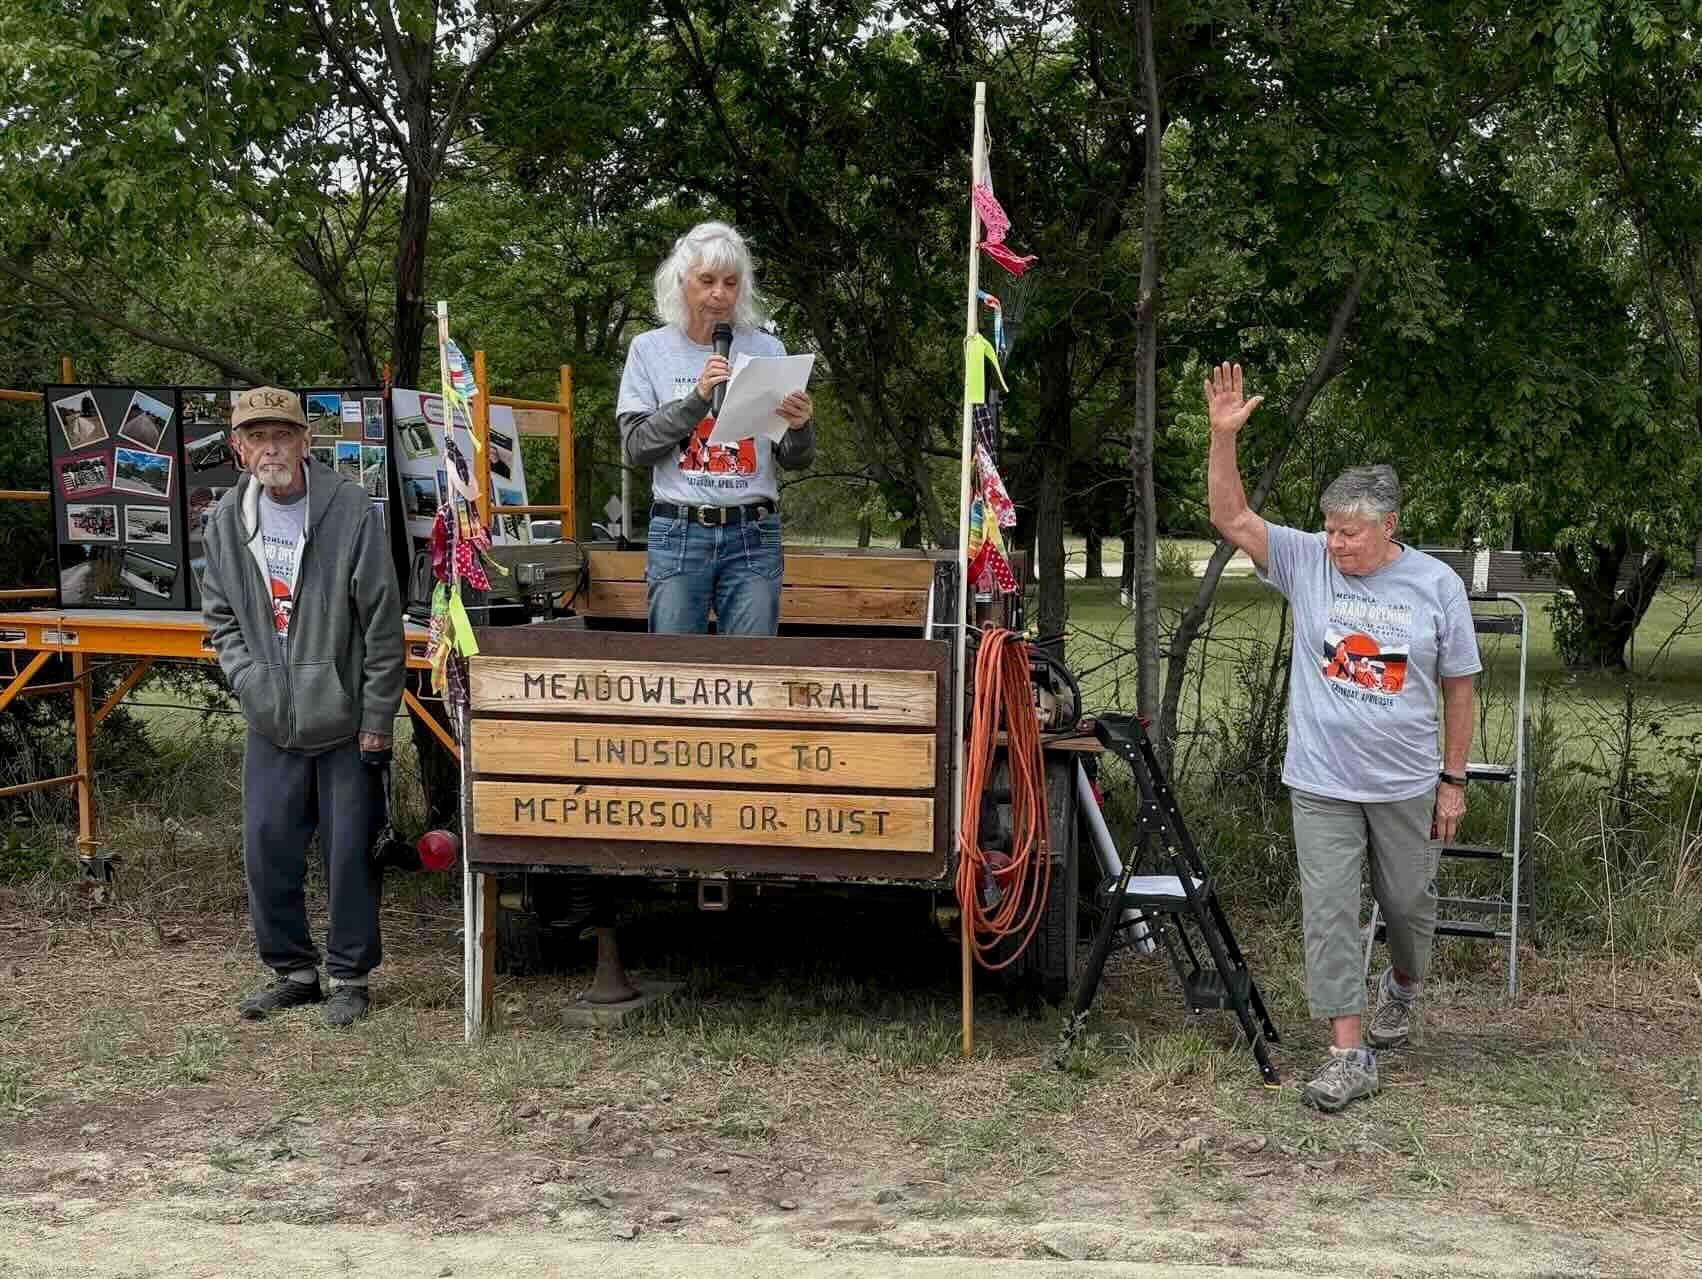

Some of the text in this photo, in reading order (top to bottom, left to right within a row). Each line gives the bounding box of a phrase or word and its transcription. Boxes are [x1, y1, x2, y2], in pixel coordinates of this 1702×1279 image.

[718, 479, 734, 489] APRIL
[523, 672, 879, 711] MEADOWLARK TRAIL
[573, 737, 833, 773] LINDSBORG TO
[513, 797, 890, 836] MCPHERSON OR BUST
